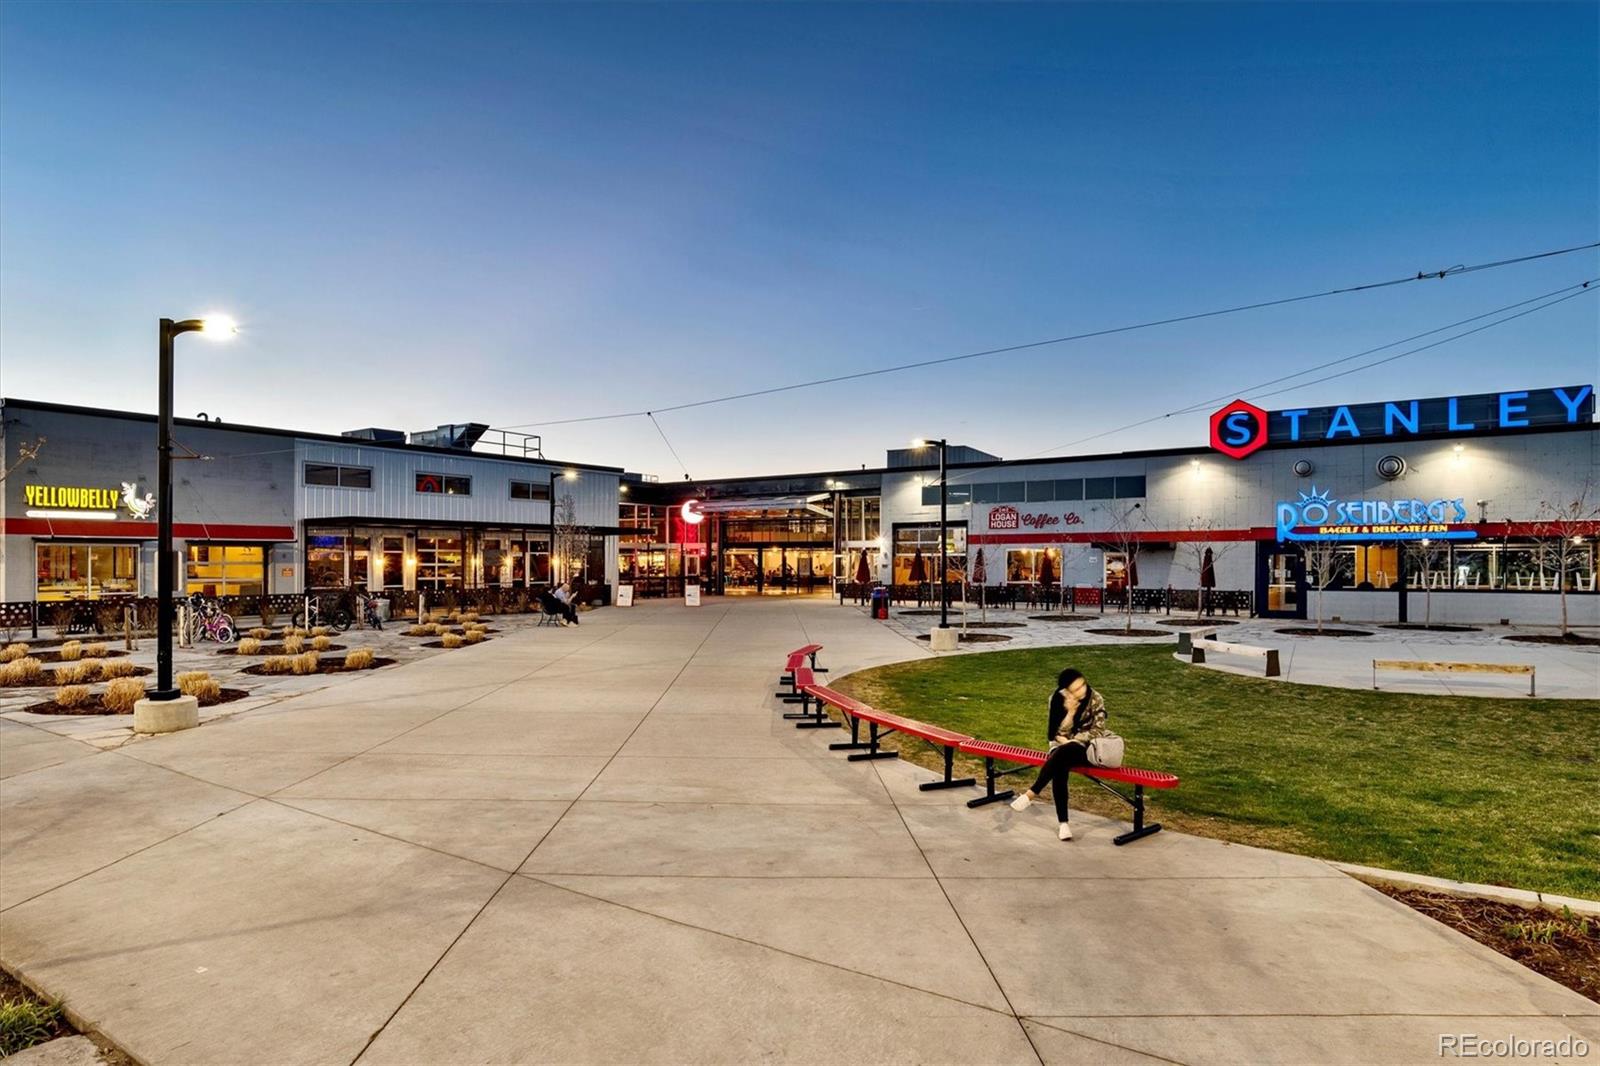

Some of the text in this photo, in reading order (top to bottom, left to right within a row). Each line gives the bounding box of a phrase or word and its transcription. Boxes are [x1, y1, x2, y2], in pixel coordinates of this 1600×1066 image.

[1226, 386, 1592, 445] STANLEY
[25, 485, 119, 509] YELLOWBELLY
[991, 513, 1017, 521] LOGAN
[991, 520, 1017, 529] HOUSE
[1021, 512, 1084, 529] Coffee Co.
[1276, 498, 1468, 542] ROSENBERG'S
[1319, 526, 1359, 534] BAGELS
[1371, 525, 1448, 534] DELICATESSEN
